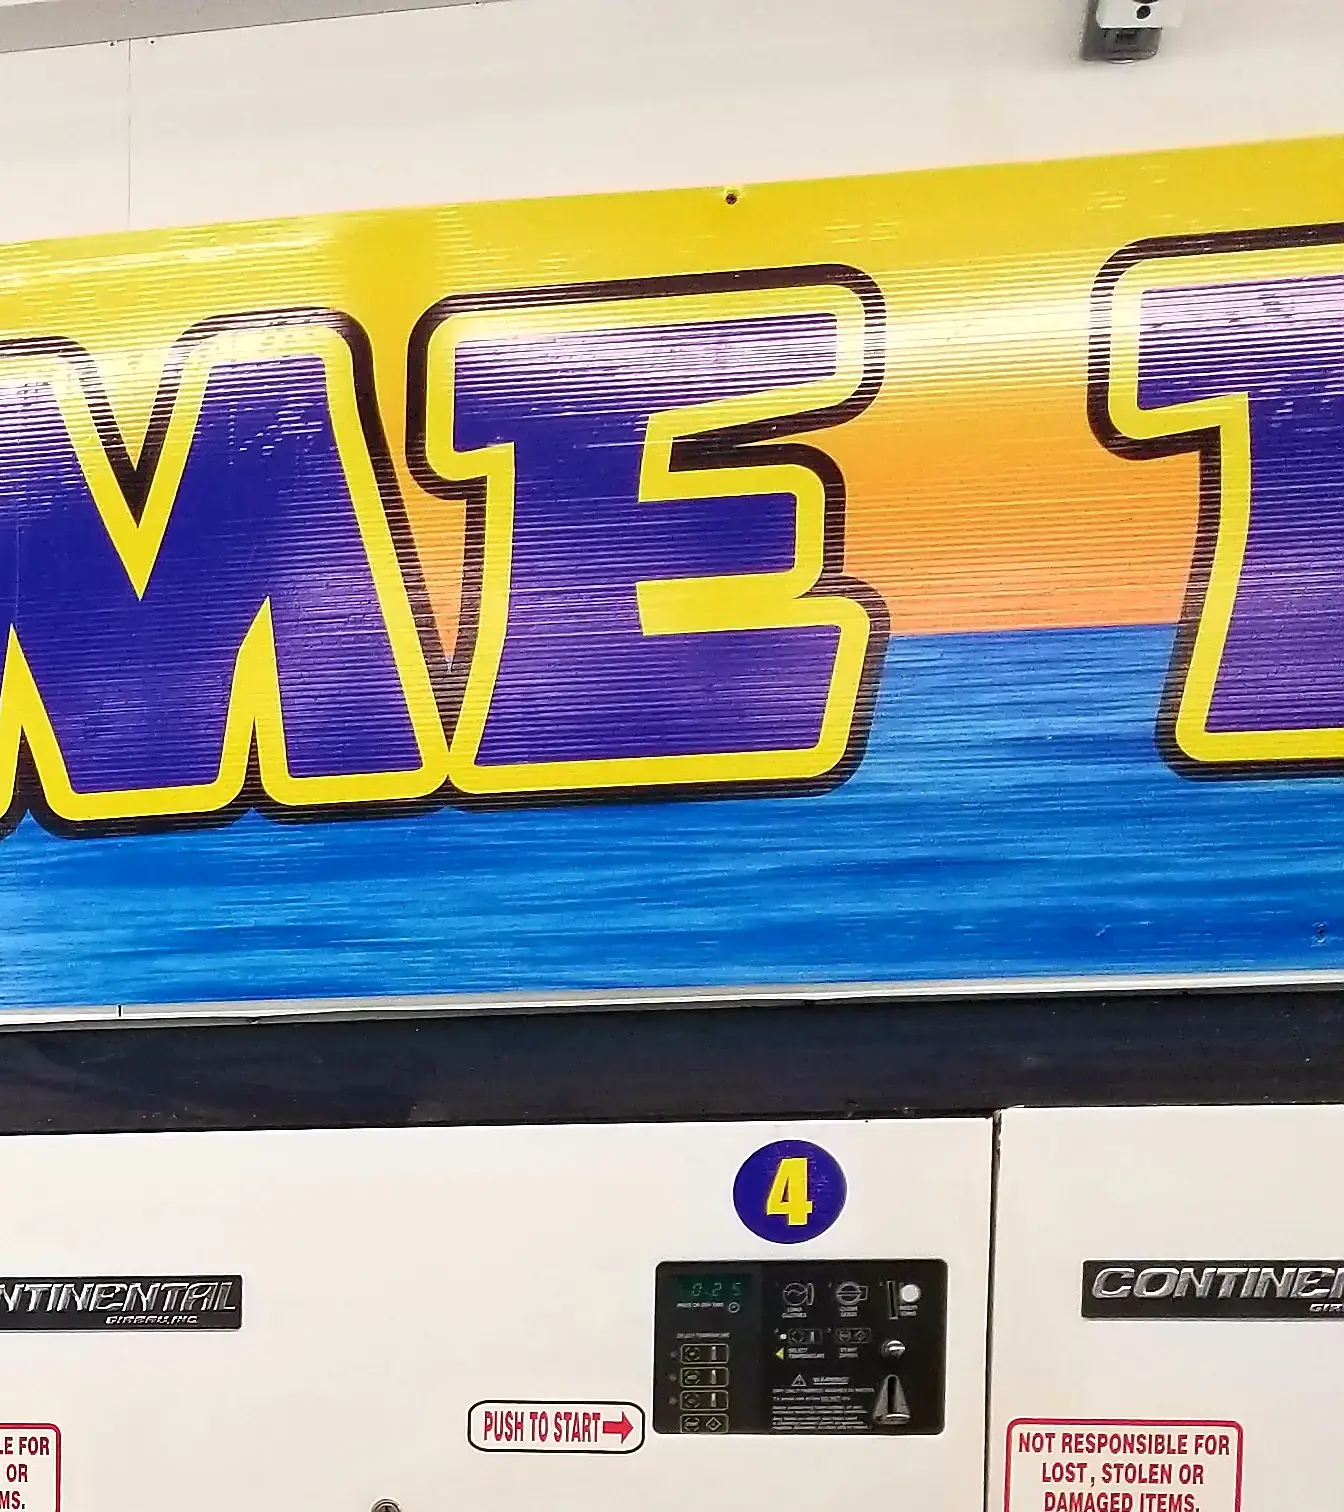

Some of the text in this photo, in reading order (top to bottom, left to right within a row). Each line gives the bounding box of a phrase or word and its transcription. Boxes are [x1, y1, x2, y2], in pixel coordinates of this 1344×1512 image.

[766, 1157, 814, 1226] 4
[483, 1410, 601, 1443] PUSH TO START
[18, 1435, 50, 1456] FOR
[1018, 1433, 1230, 1456] NOT RESPONSIBLE FOR
[5, 1462, 29, 1483] OR
[1101, 1462, 1173, 1485] STOLEN
[1178, 1462, 1205, 1485] OR
